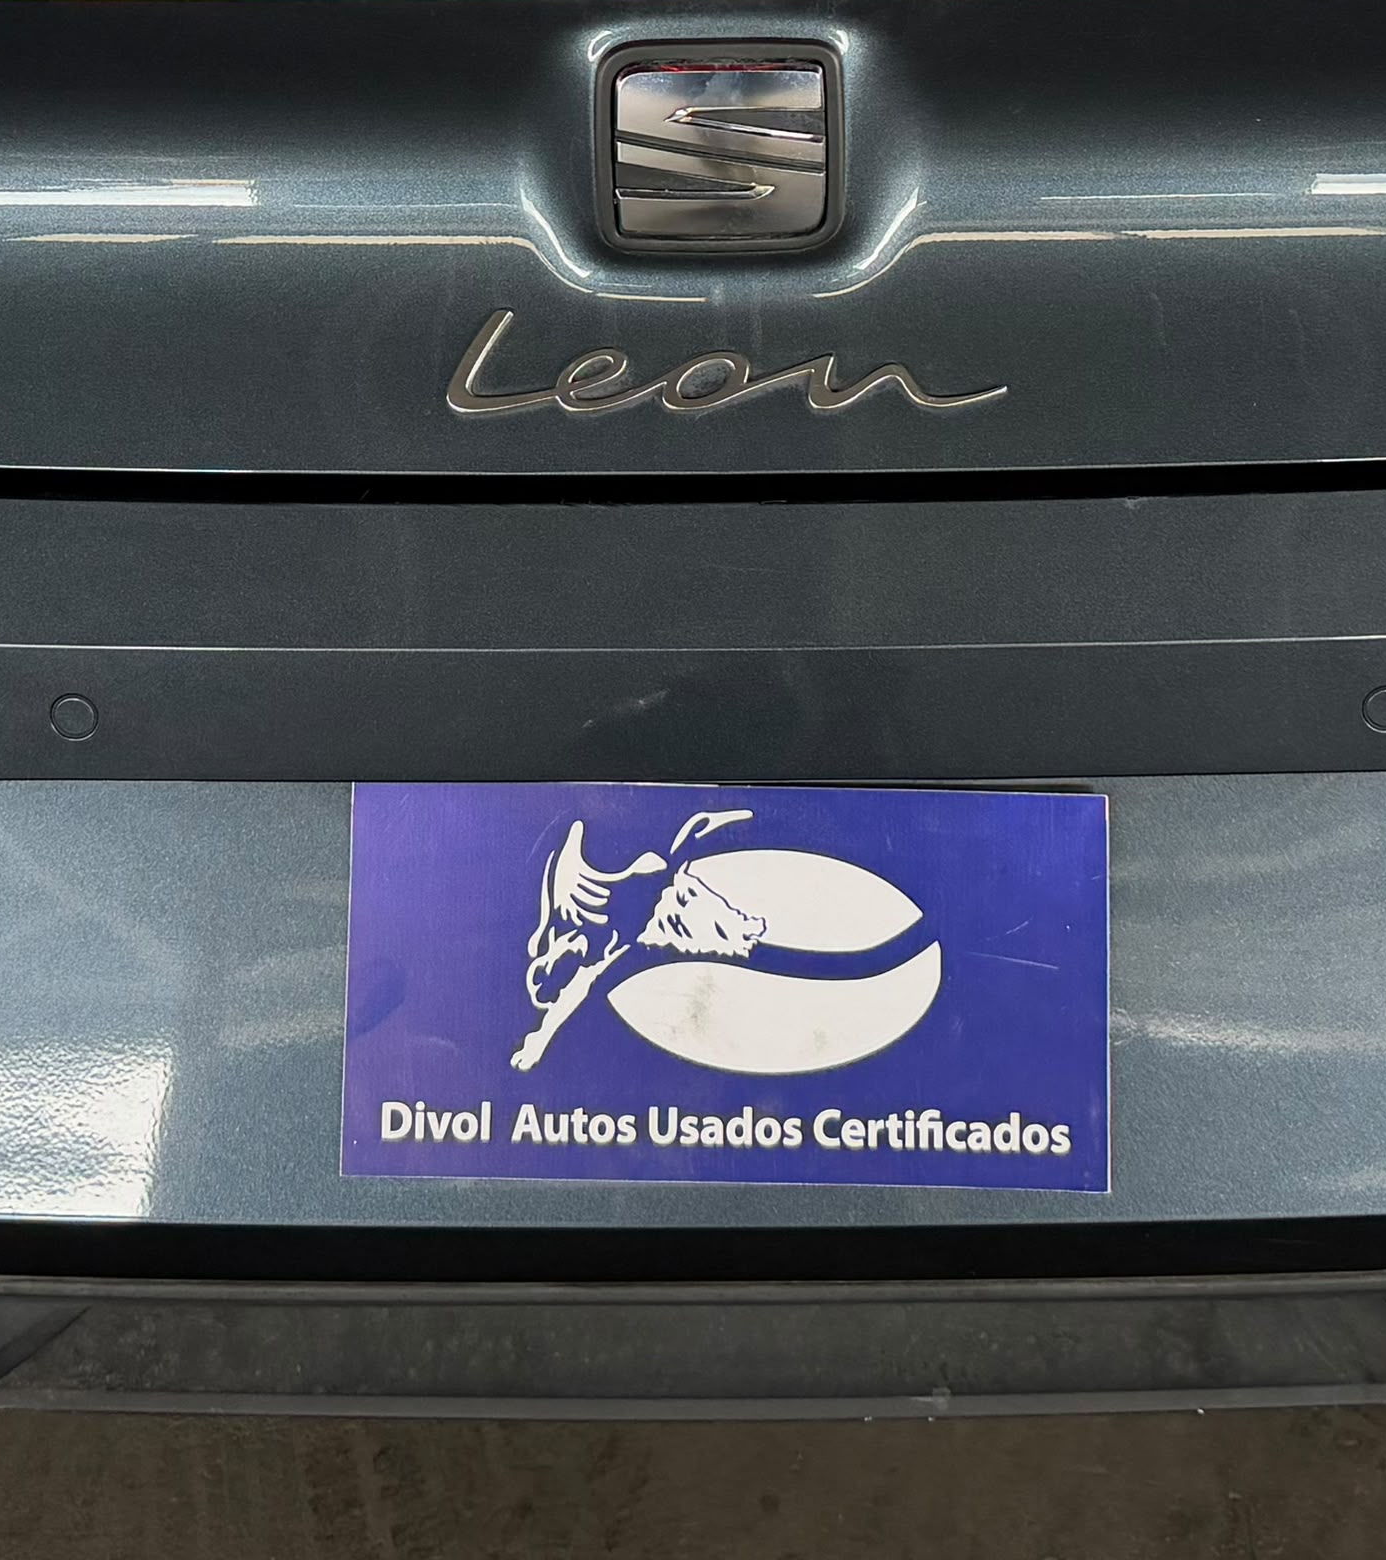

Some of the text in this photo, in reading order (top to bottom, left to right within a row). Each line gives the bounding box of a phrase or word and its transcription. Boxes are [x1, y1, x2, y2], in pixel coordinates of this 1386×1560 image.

[447, 308, 1007, 413] Leon
[380, 1100, 1072, 1155] Divol Autos Usados Certificados
